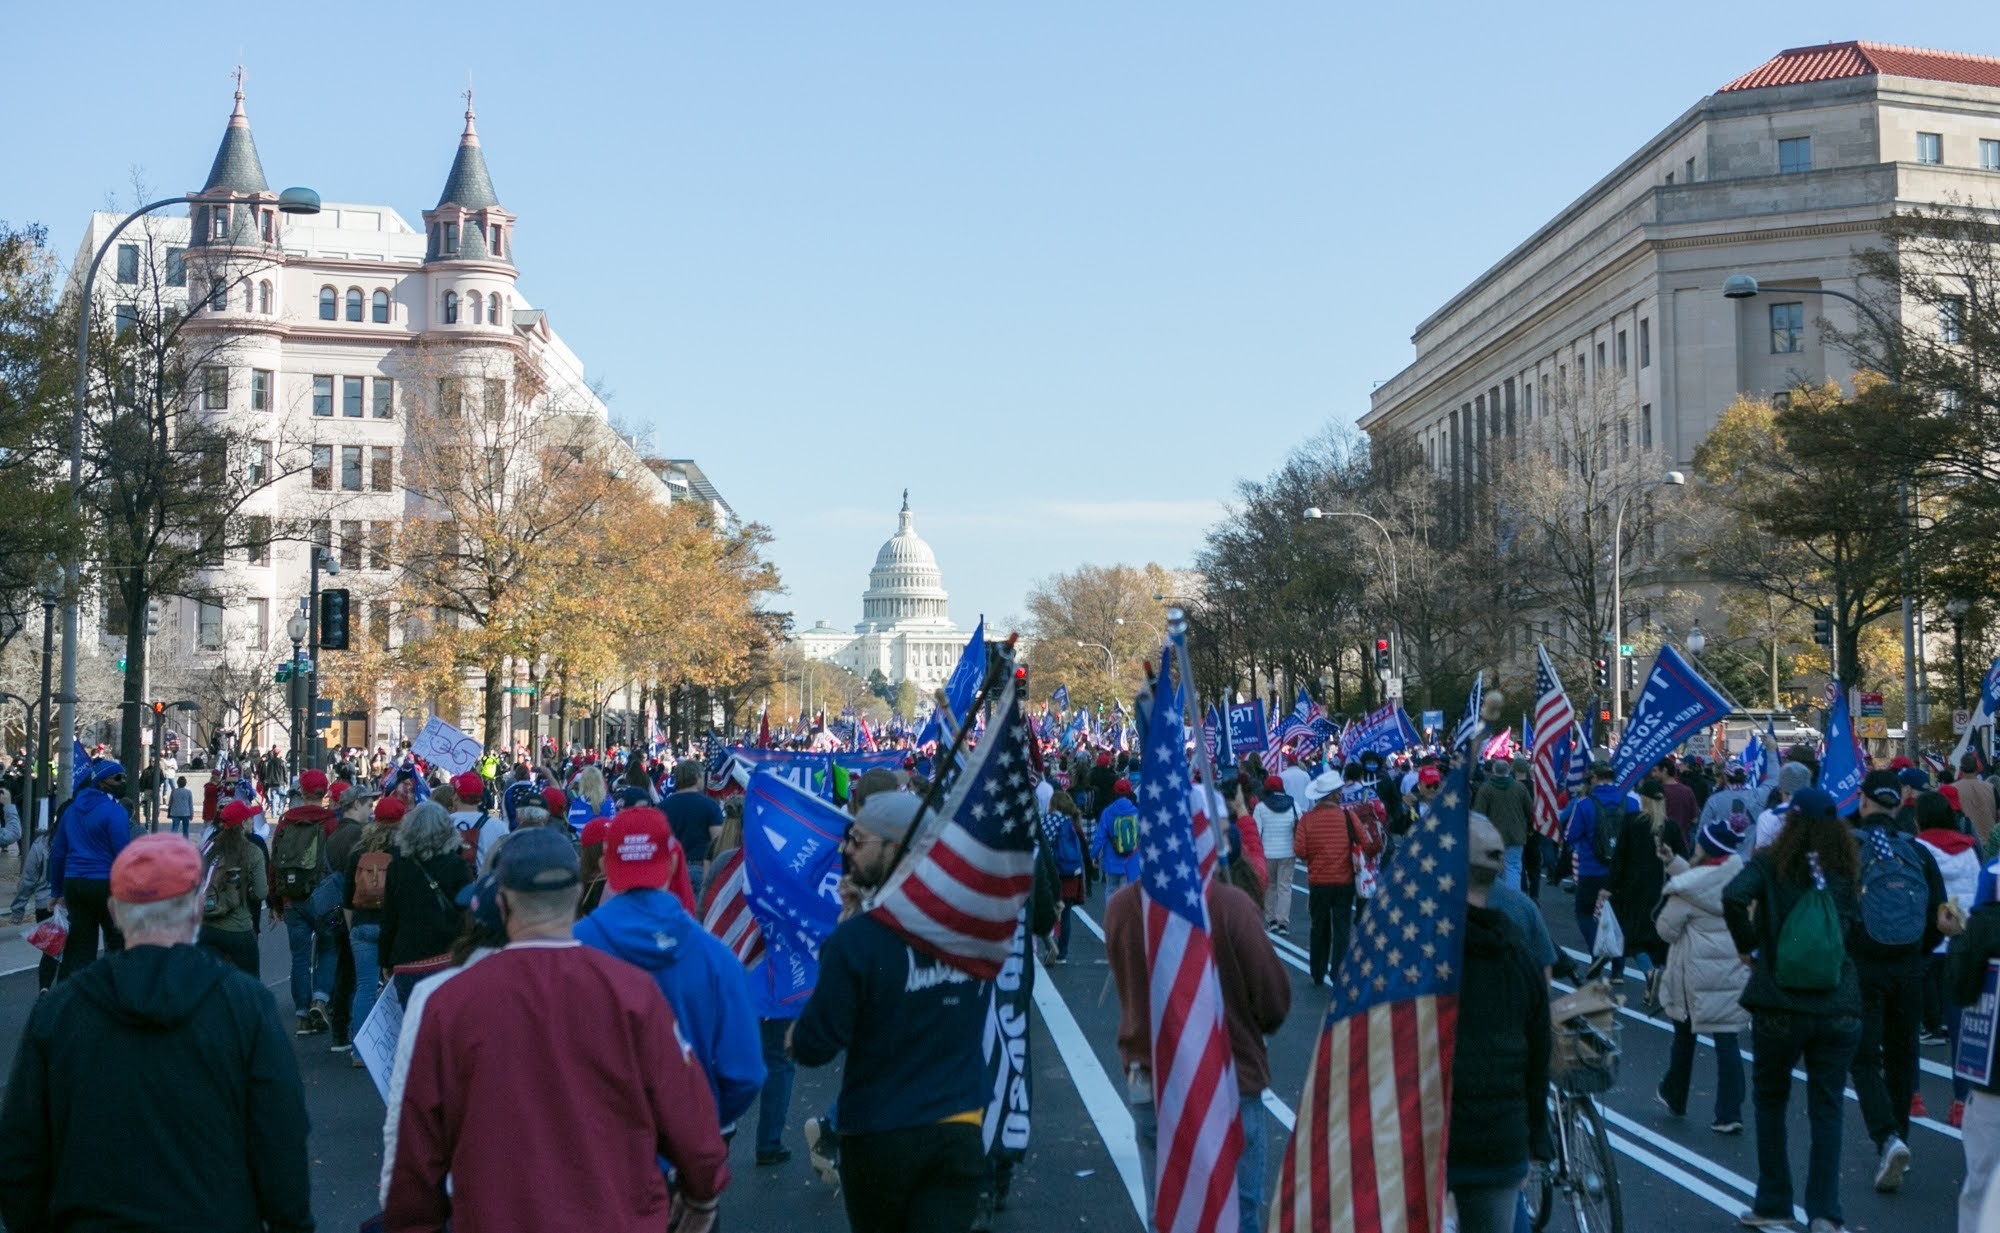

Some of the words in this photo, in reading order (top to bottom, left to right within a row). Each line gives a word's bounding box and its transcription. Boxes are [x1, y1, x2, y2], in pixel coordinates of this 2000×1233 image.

[280, 673, 286, 681] 7
[429, 721, 482, 766] 5G
[789, 952, 806, 989] GAIN!
